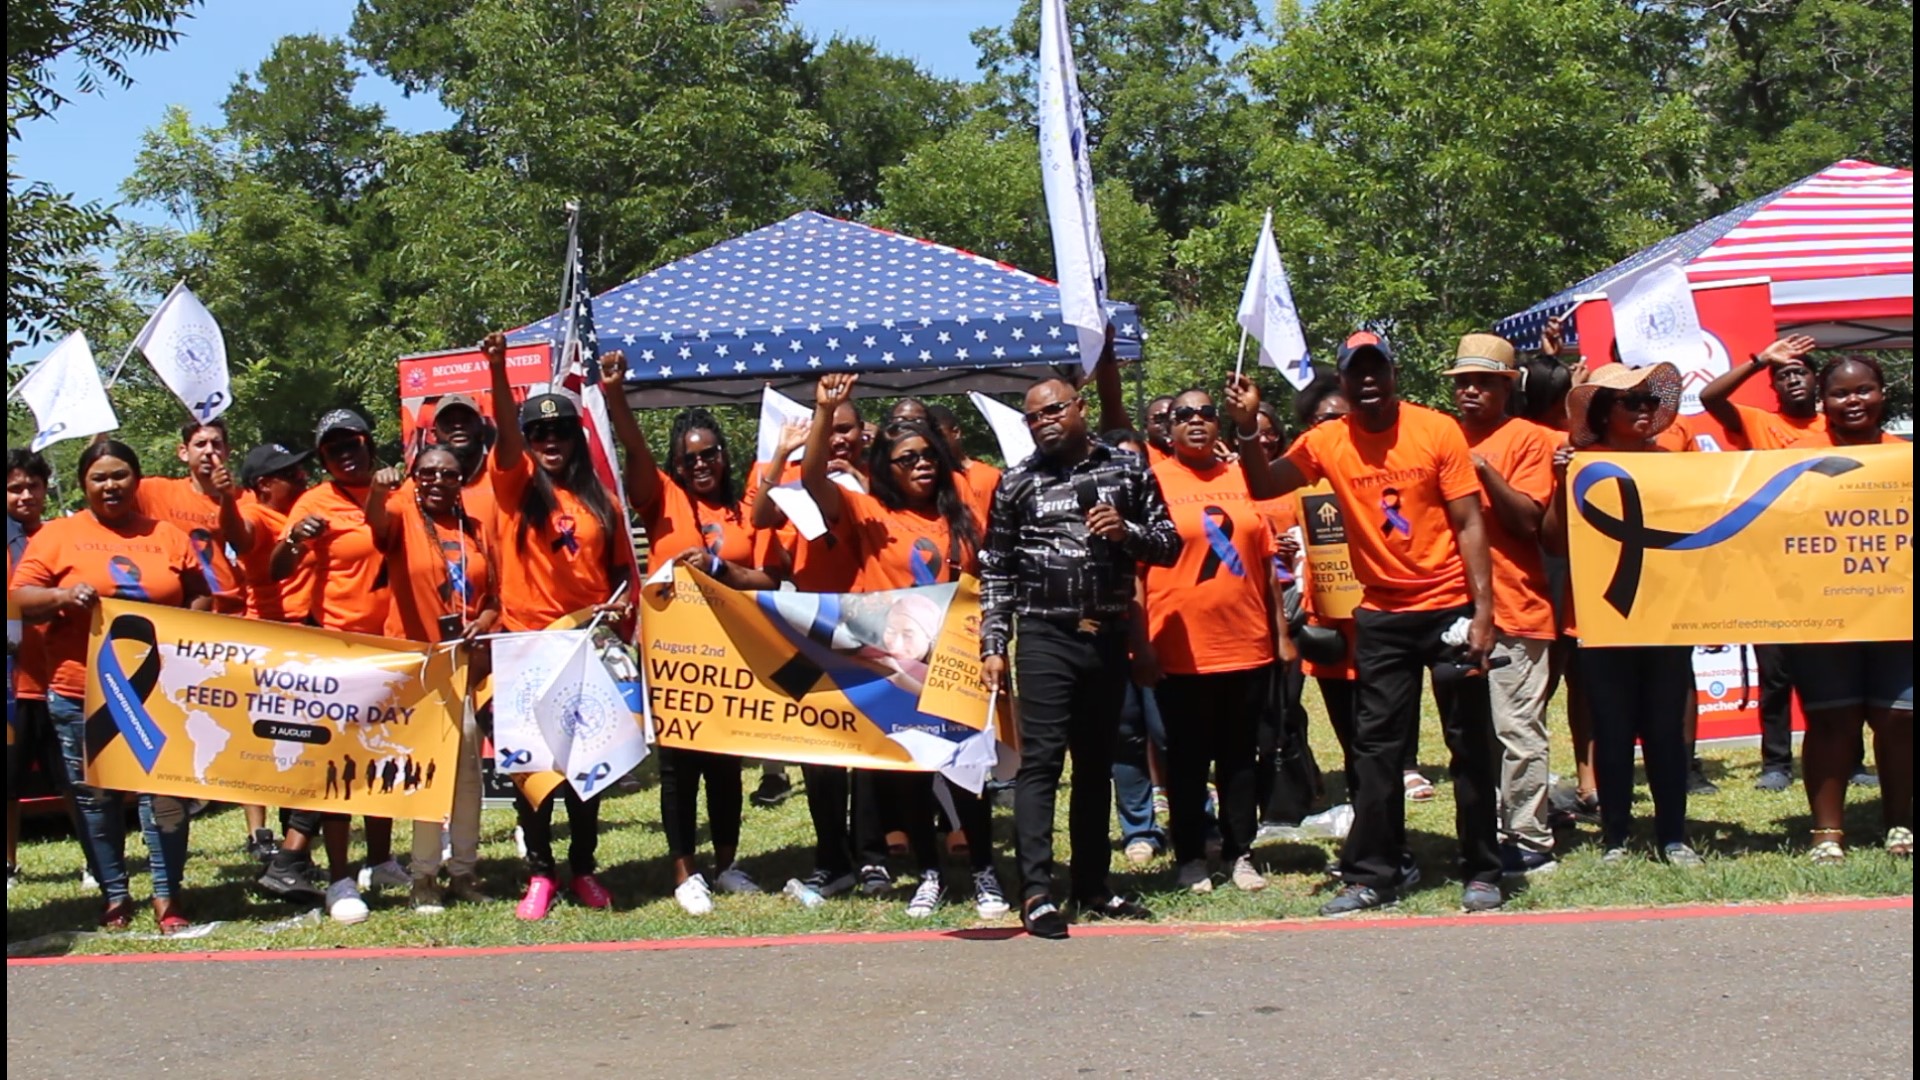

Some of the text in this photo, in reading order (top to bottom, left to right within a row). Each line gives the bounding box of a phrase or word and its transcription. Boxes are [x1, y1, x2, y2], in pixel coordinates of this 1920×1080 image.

[1838, 481, 1899, 490] AWARENESS
[1825, 509, 1909, 527] WORLD
[1785, 536, 1837, 554] FEED
[1846, 535, 1886, 553] THE
[1843, 556, 1891, 574] DAY
[1337, 571, 1353, 581] TH
[1823, 585, 1905, 597] Enriching Lives
[1671, 618, 1846, 630] www.worldfeedthepoorday.org
[176, 639, 256, 665] HAPPY
[652, 639, 726, 657] August 2nd
[932, 665, 961, 681] FEED
[936, 652, 978, 676] WORLD
[253, 667, 339, 694] WORLD
[651, 658, 754, 690] WORLD
[928, 677, 954, 692] DAY
[186, 685, 415, 726] FEED THE POOR DAY
[649, 687, 857, 732] FEED THE POOR
[270, 726, 312, 738] 2 AUGUST
[651, 715, 701, 742] DAY
[240, 752, 316, 768] Enriching Lives
[157, 773, 317, 798] www.worldfeedthepoorday.org
